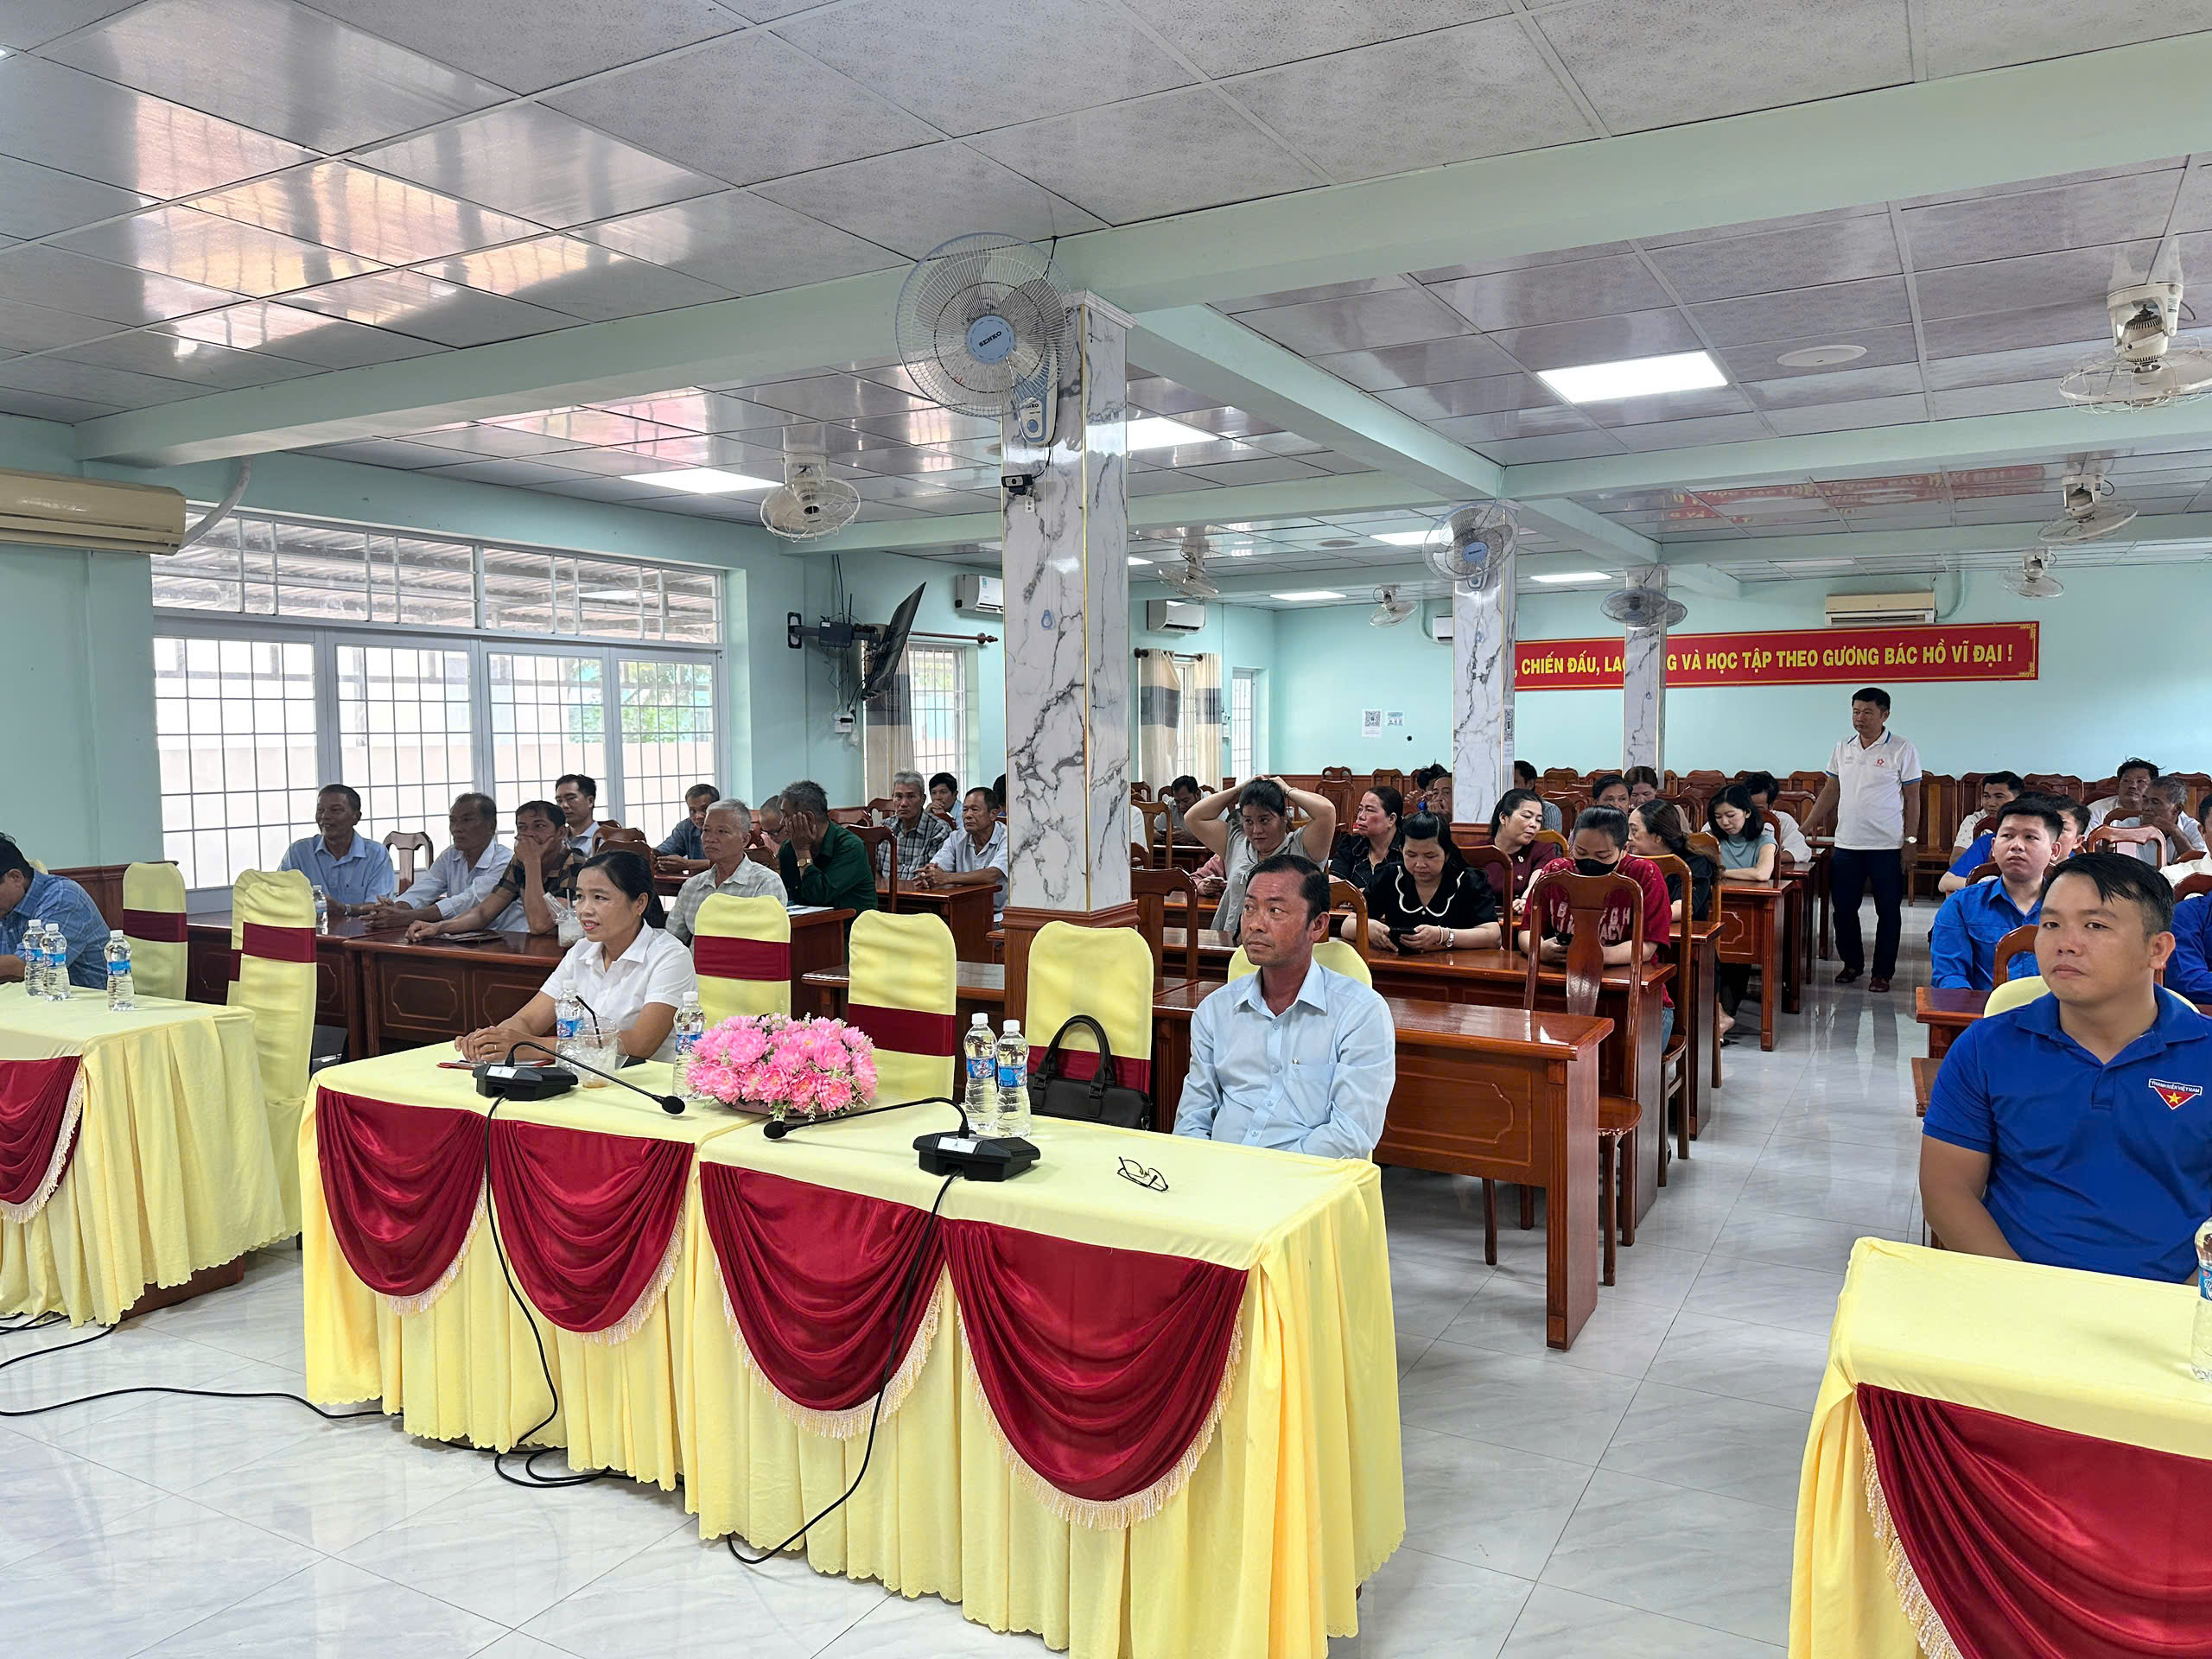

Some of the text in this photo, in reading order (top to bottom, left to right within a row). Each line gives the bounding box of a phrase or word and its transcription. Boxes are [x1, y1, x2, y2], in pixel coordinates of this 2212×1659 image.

[1521, 651, 1564, 675] CHIẾN
[1567, 650, 1600, 676] ĐẤU,
[1605, 656, 1625, 672] LA
[1681, 649, 1701, 671] VÀ
[1706, 652, 1738, 674] HỌC
[1741, 647, 1772, 673] TẬP
[1776, 649, 1818, 667] THEO
[1822, 645, 1879, 666] GƯƠNG
[1885, 642, 1918, 664] BÁC
[1923, 639, 1946, 664] HỒ
[1951, 640, 1969, 663] VĨ
[1973, 644, 2002, 668] ĐẠI
